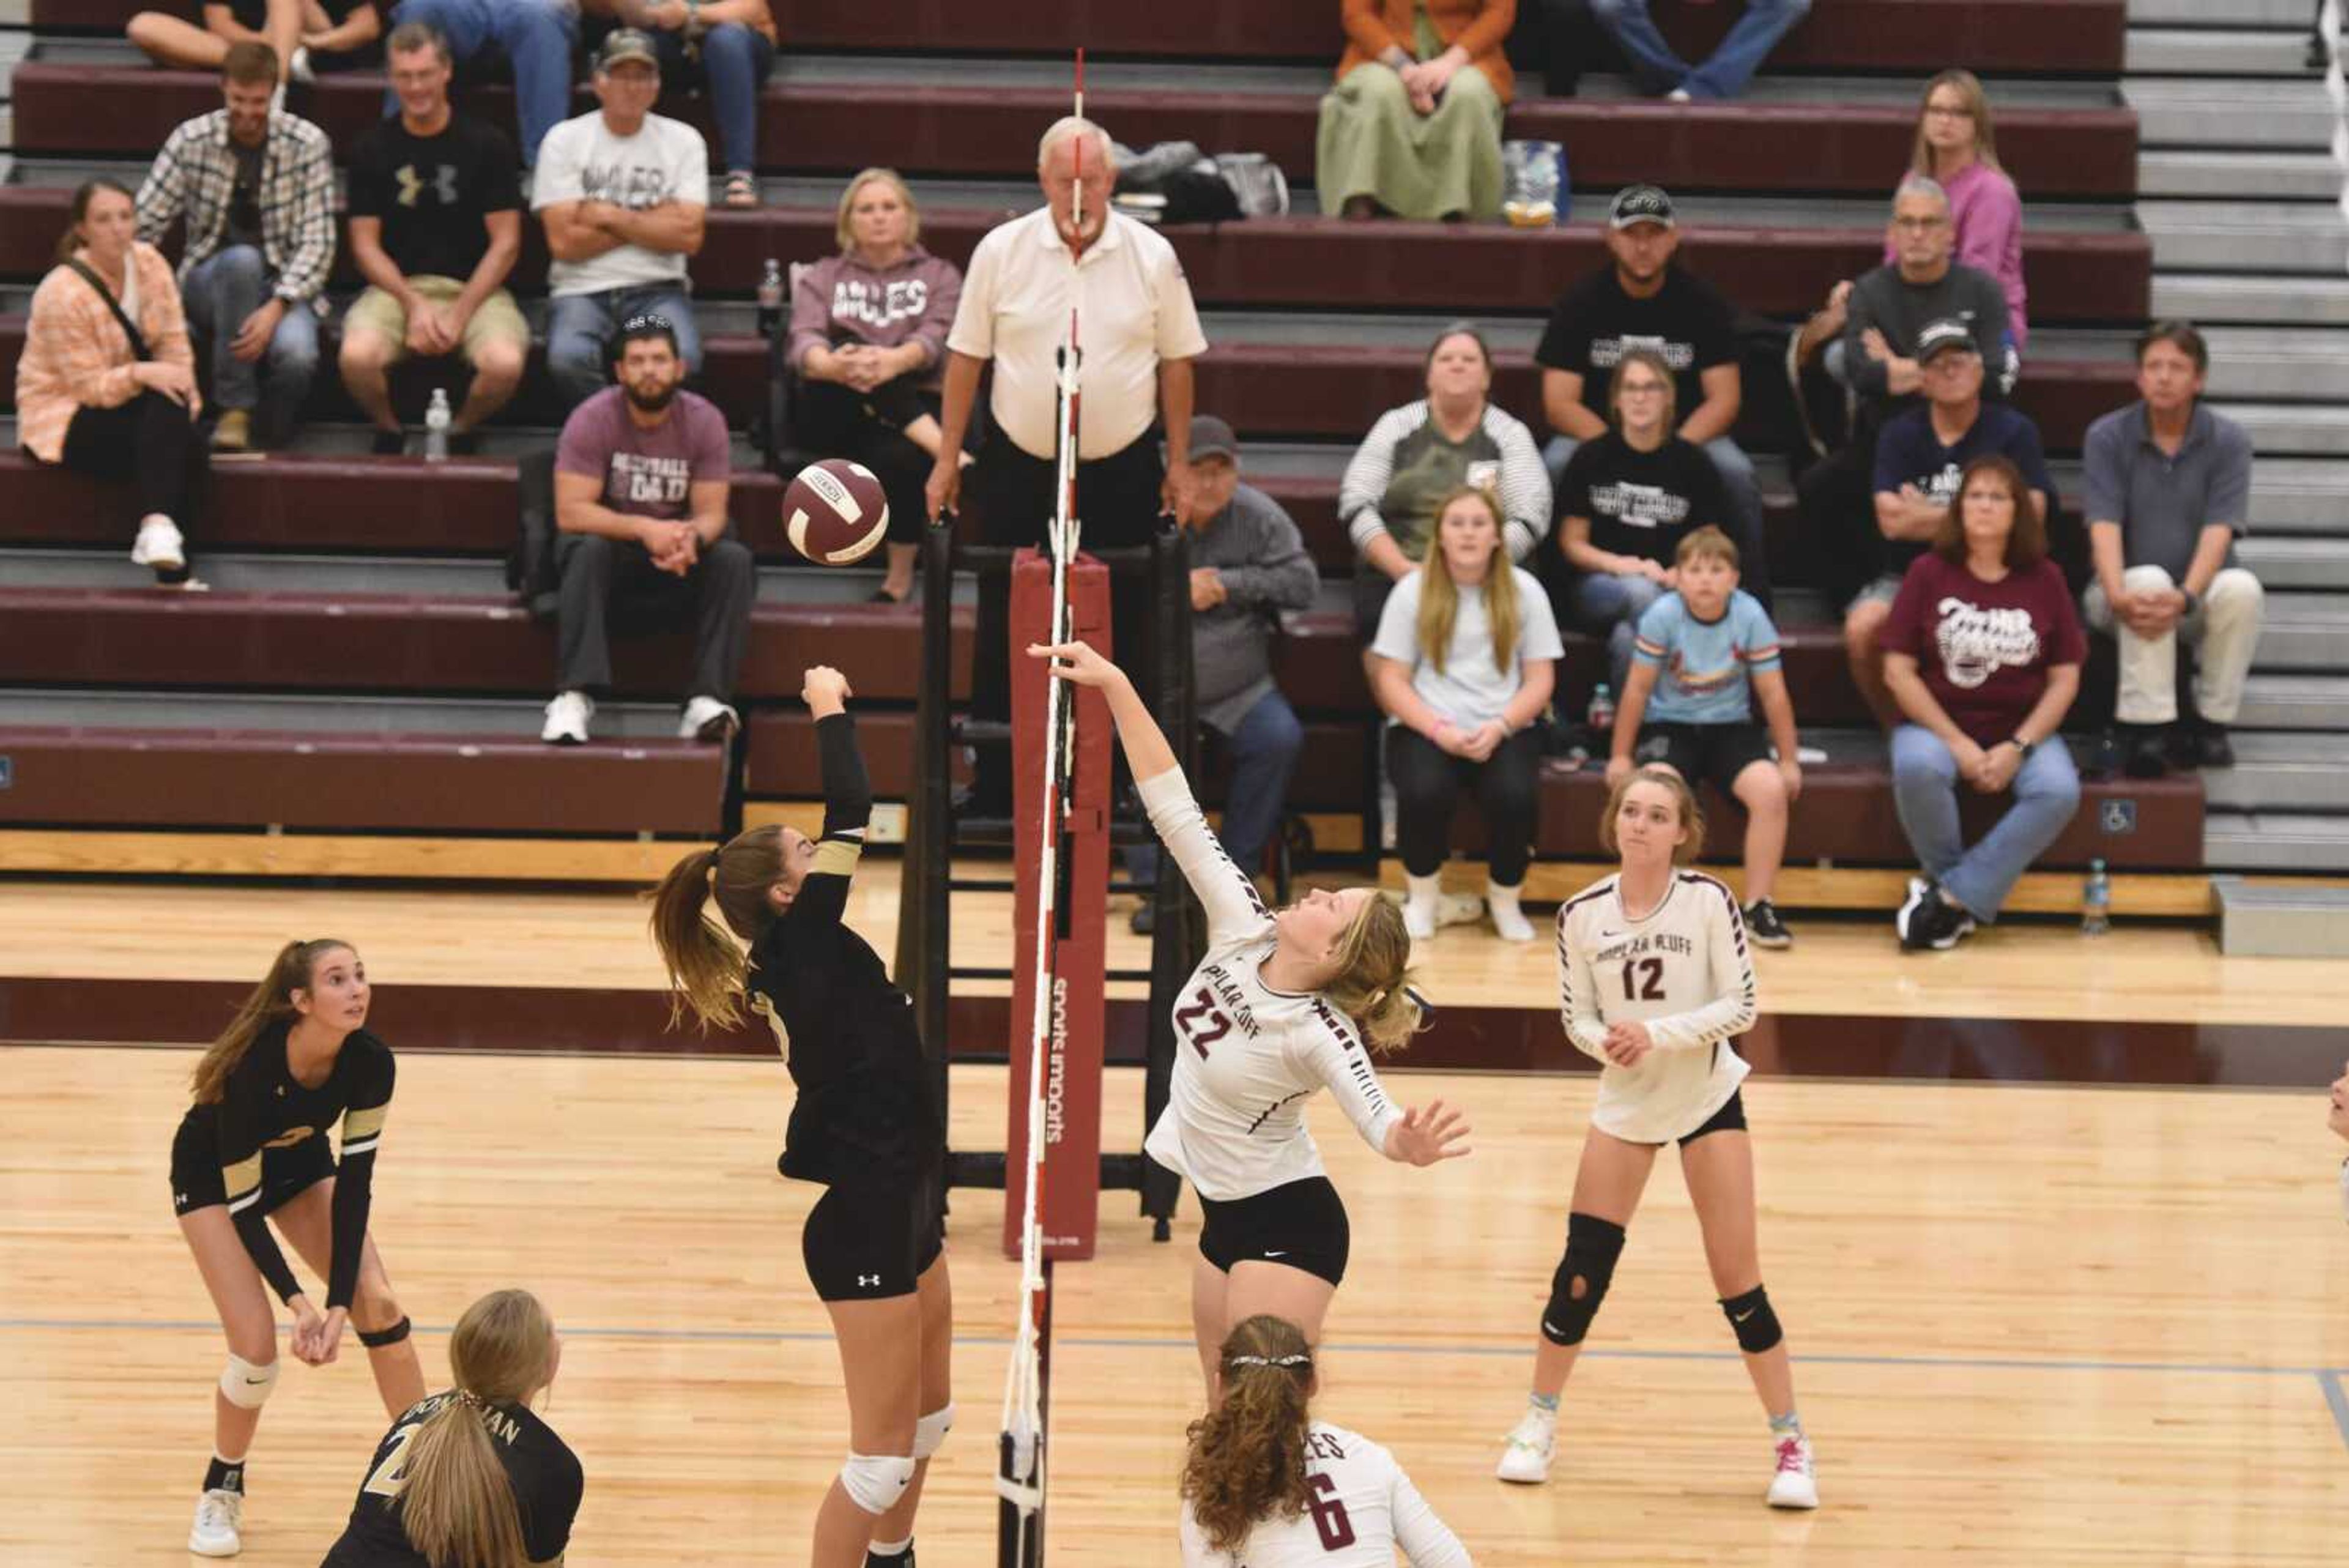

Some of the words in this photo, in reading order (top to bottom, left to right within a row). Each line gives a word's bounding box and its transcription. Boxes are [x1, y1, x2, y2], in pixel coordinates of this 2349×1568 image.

[1051, 978, 1069, 1050] sports
[1622, 957, 1666, 1000] 12
[1175, 987, 1232, 1062] 22
[1046, 1053, 1066, 1144] imports
[1304, 1472, 1356, 1551] 6
